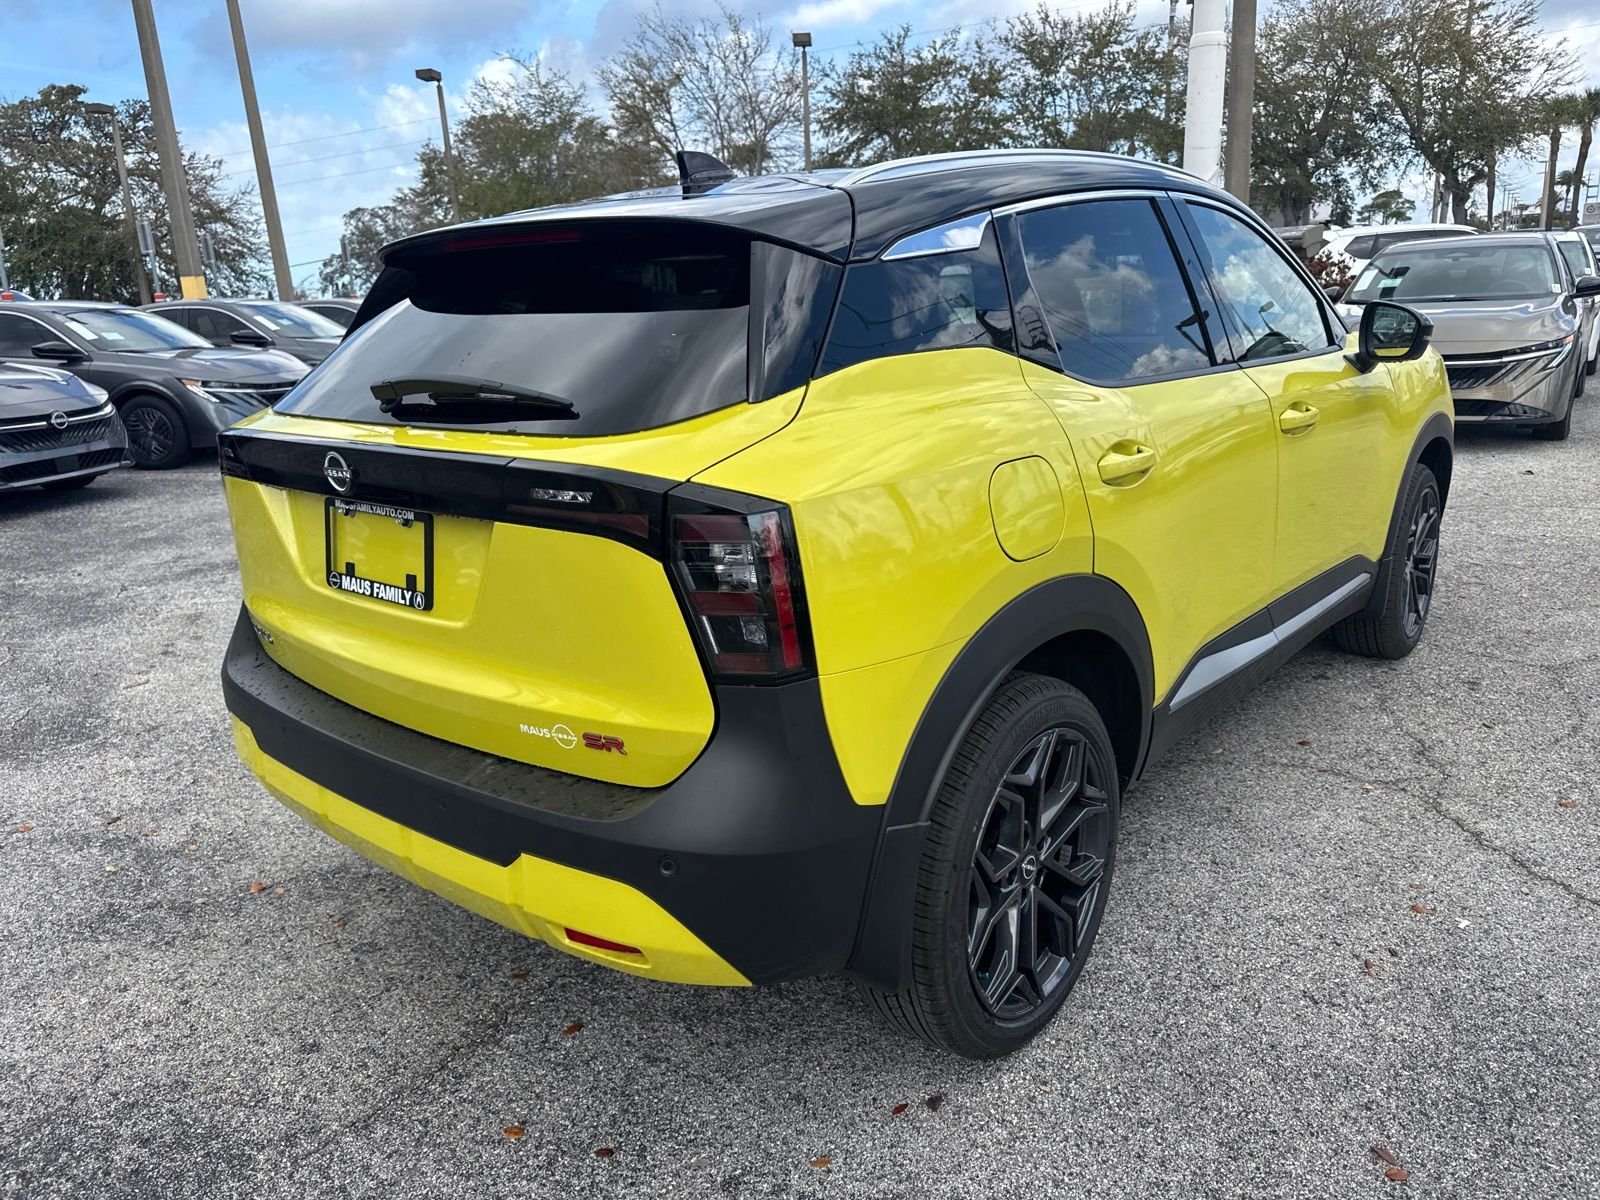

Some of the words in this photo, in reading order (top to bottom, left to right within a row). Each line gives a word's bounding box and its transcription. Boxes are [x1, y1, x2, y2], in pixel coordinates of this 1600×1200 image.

[325, 469, 350, 478] SSAN
[341, 575, 371, 595] MAUS
[373, 582, 412, 605] FAMILY
[520, 723, 551, 738] MAUS
[582, 732, 628, 755] SR
